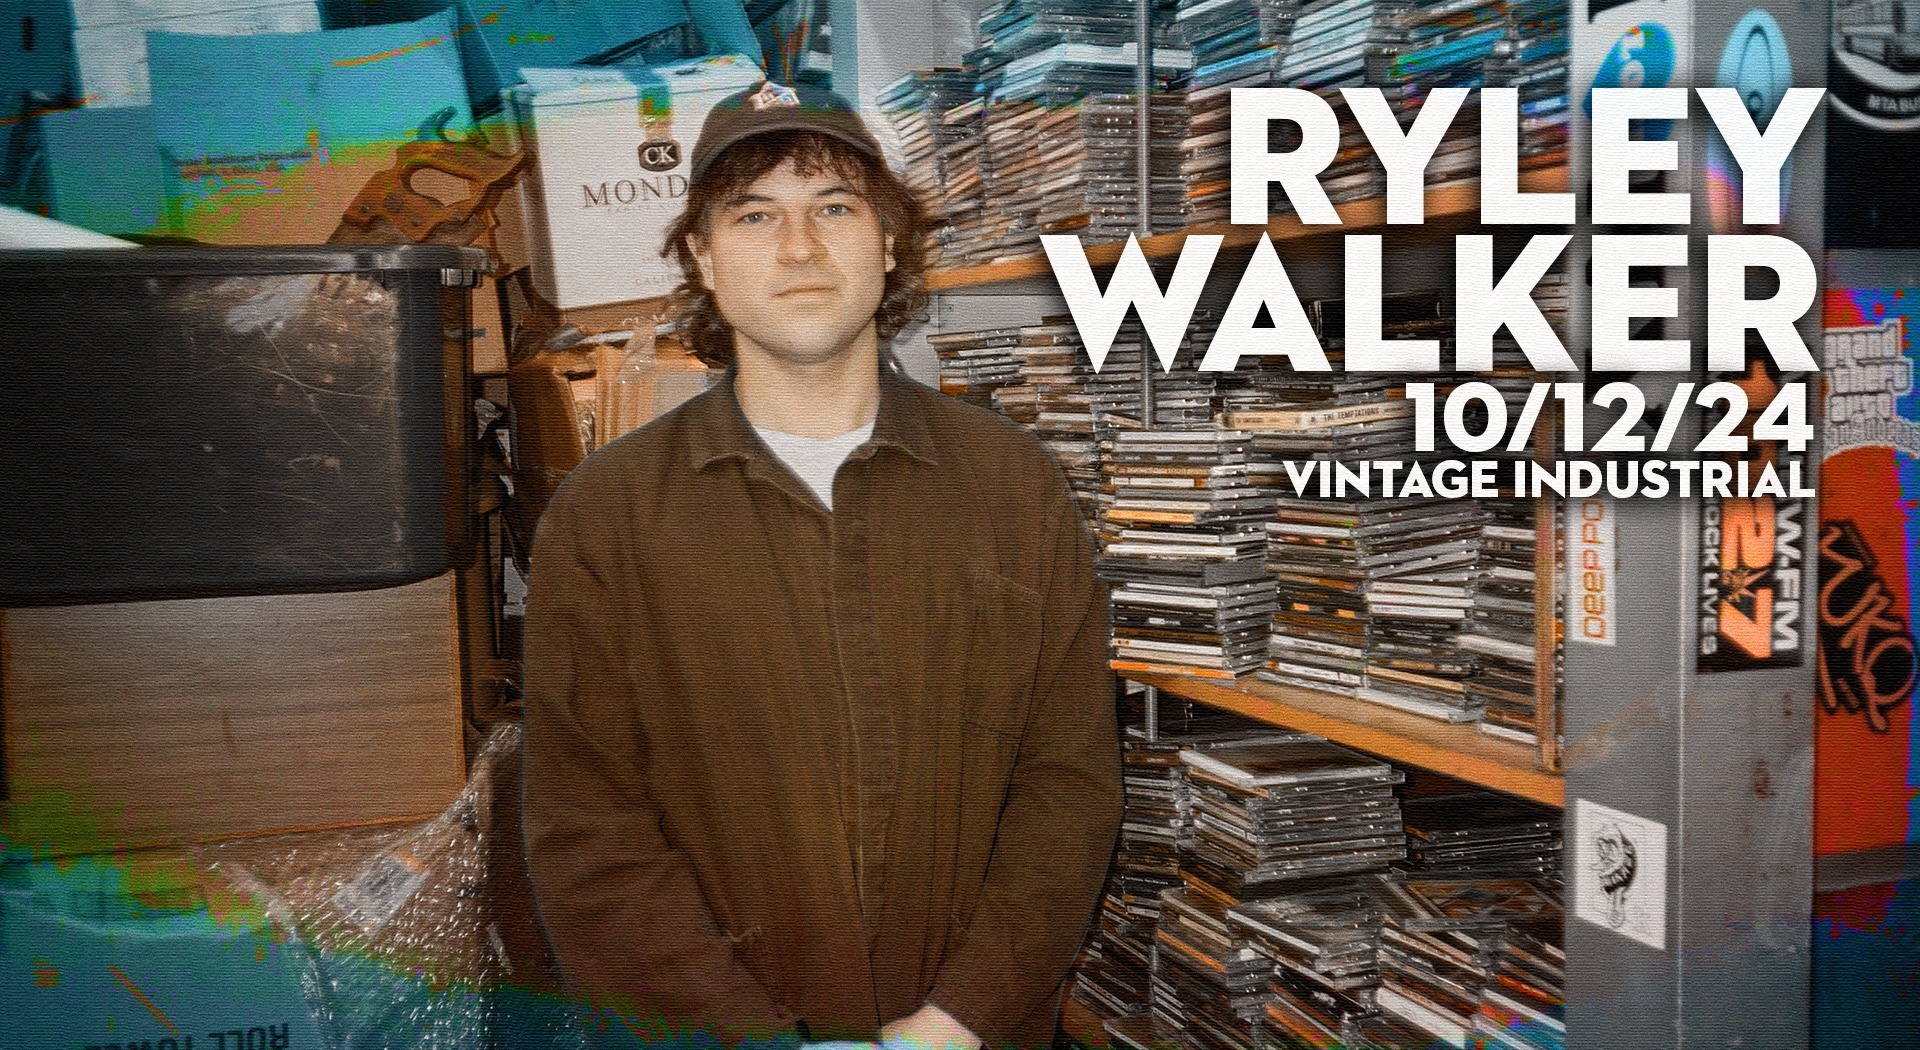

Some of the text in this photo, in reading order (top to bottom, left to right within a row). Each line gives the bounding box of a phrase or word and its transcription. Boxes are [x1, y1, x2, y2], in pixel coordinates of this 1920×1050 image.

[645, 144, 676, 164] CK
[583, 174, 689, 208] MOND
[207, 1022, 290, 1050] ROLL
